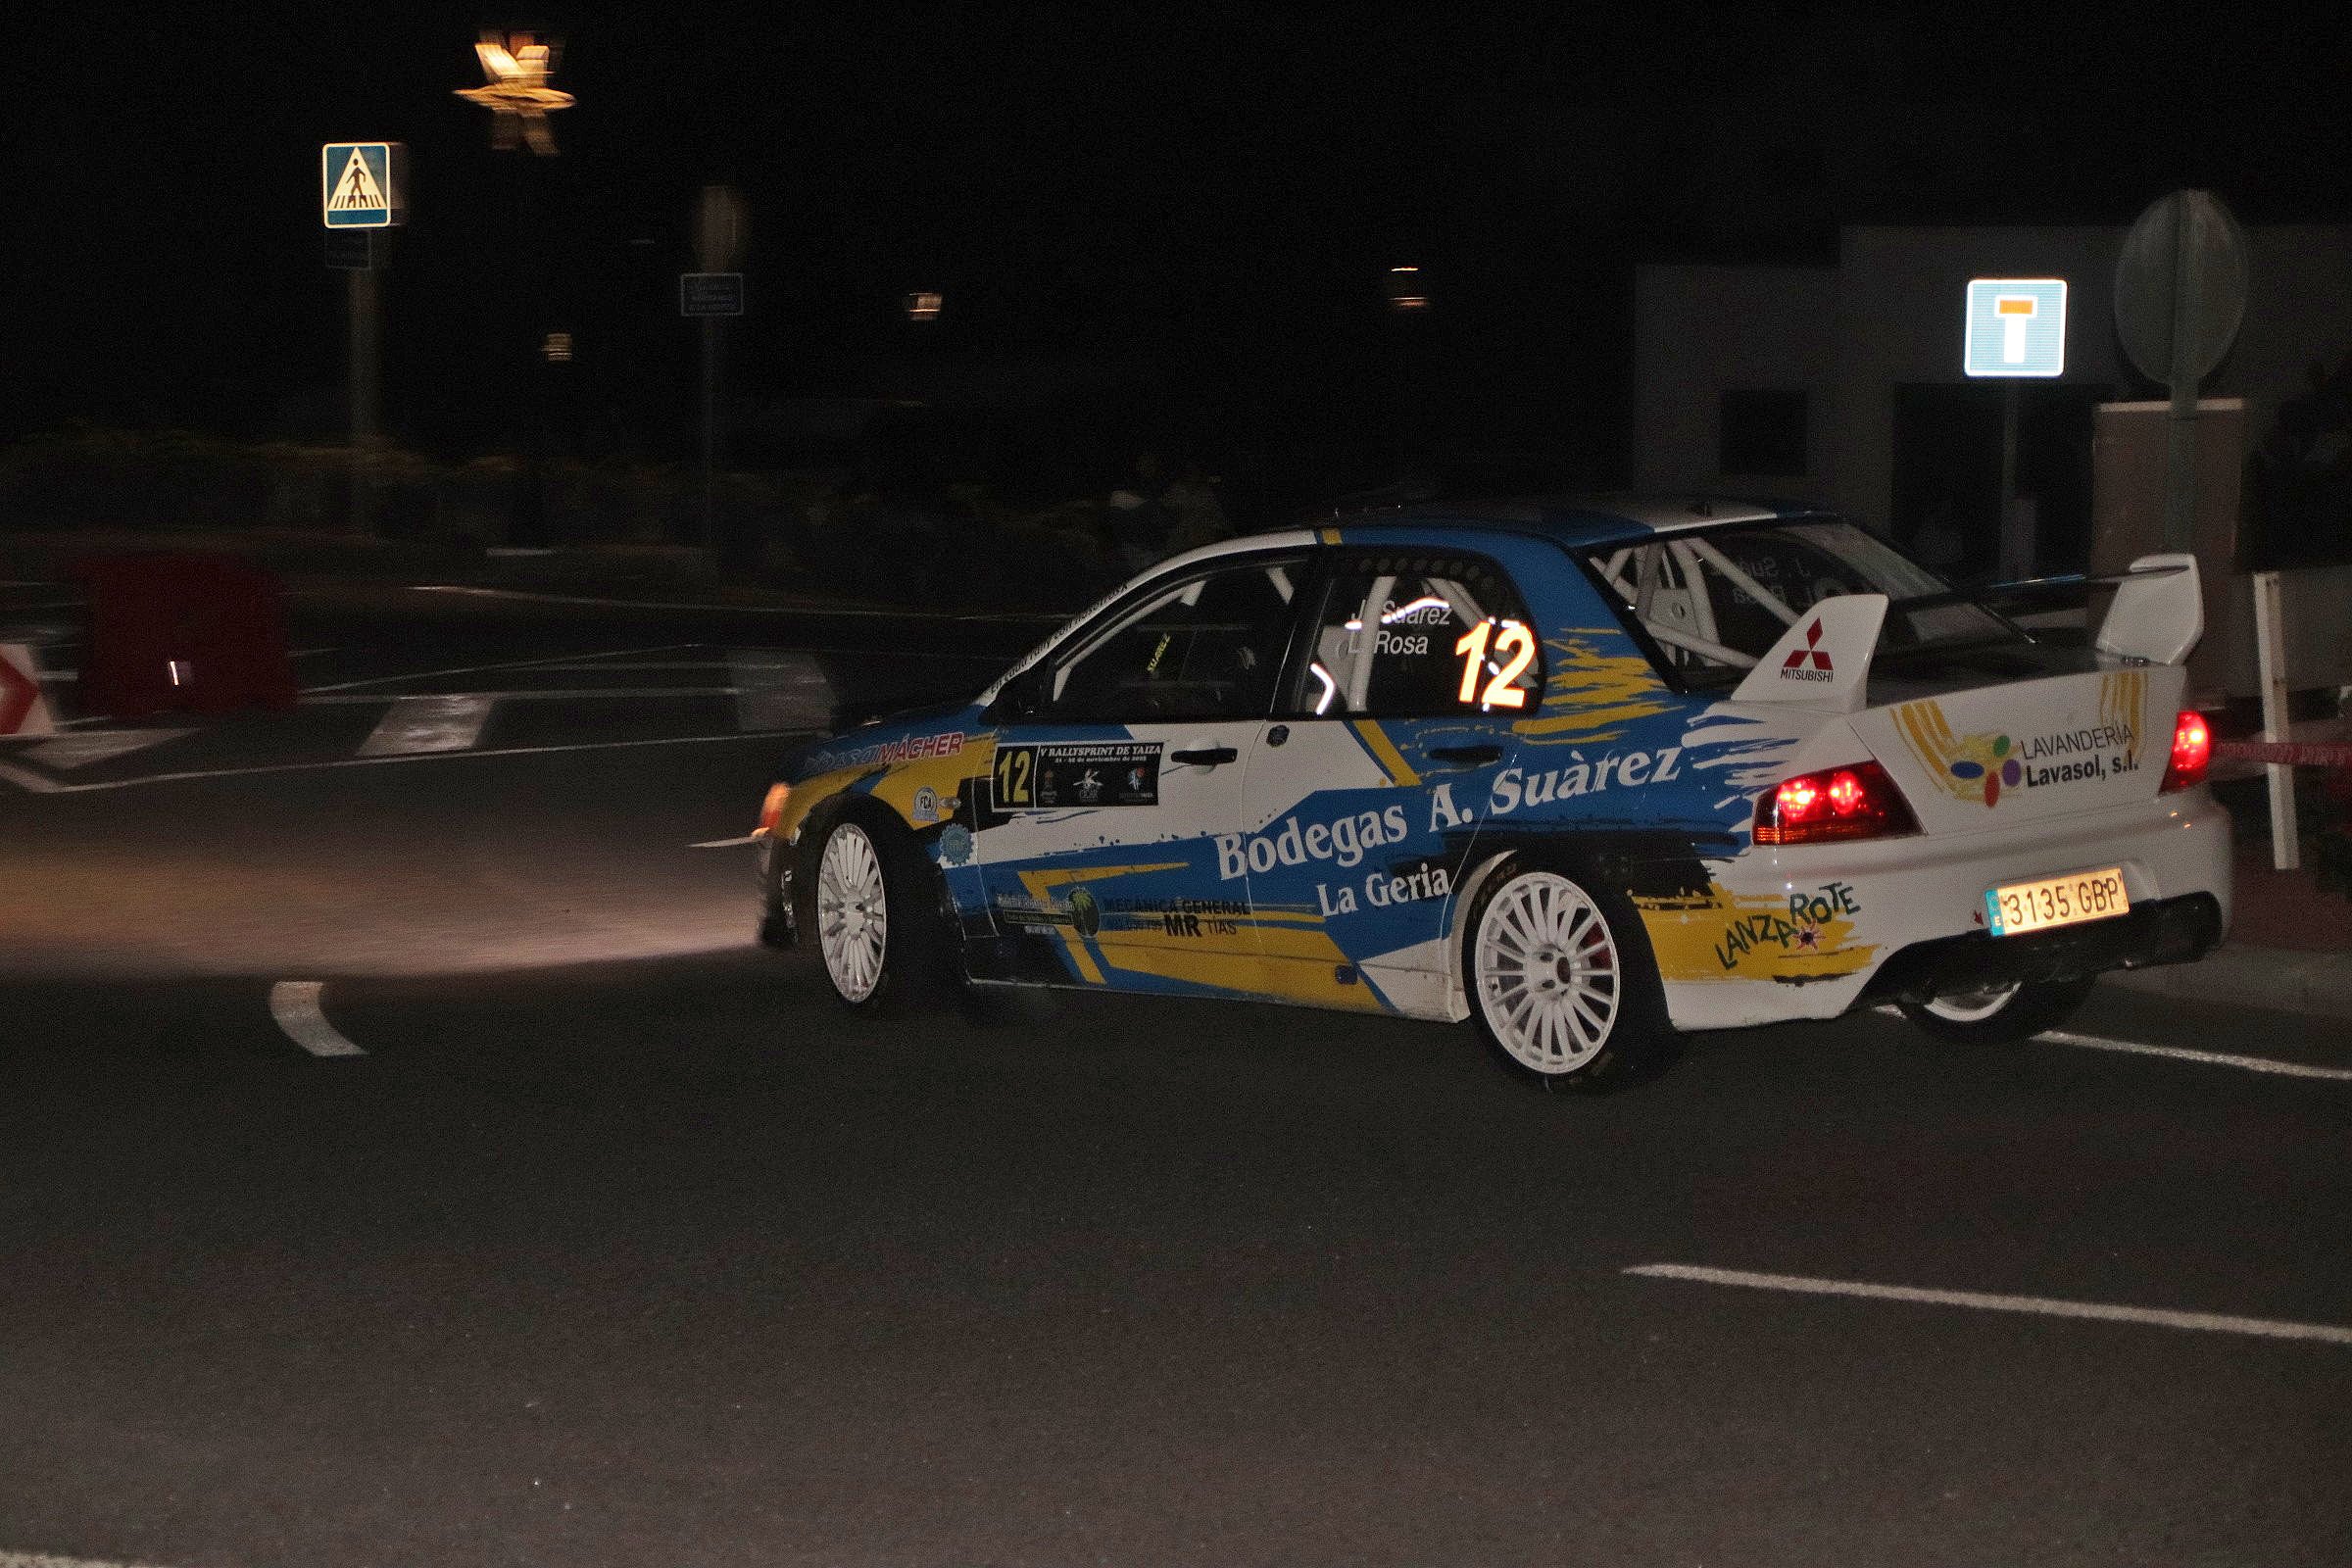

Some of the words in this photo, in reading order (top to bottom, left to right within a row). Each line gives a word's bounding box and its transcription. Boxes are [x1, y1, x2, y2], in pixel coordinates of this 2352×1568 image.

[1374, 630, 1429, 655] Rosa
[1455, 620, 1536, 708] 12
[1780, 668, 1834, 683] MITSUBISHI
[1116, 746, 1130, 756] DE
[1132, 745, 1161, 755] YAIZA
[2027, 754, 2106, 787] Lavasol,
[2112, 749, 2138, 774] s.l.
[999, 751, 1031, 803] 12
[1214, 805, 1408, 881] Bodegas
[1429, 783, 1473, 832] A.
[1181, 899, 1251, 915] GENERAL
[1316, 883, 1359, 917] La
[1365, 862, 1452, 906] Geria
[2003, 885, 2071, 926] 3135
[2078, 876, 2120, 915] GBP
[1164, 913, 1202, 937] MR
[1715, 881, 1862, 970] LANZAROTE
